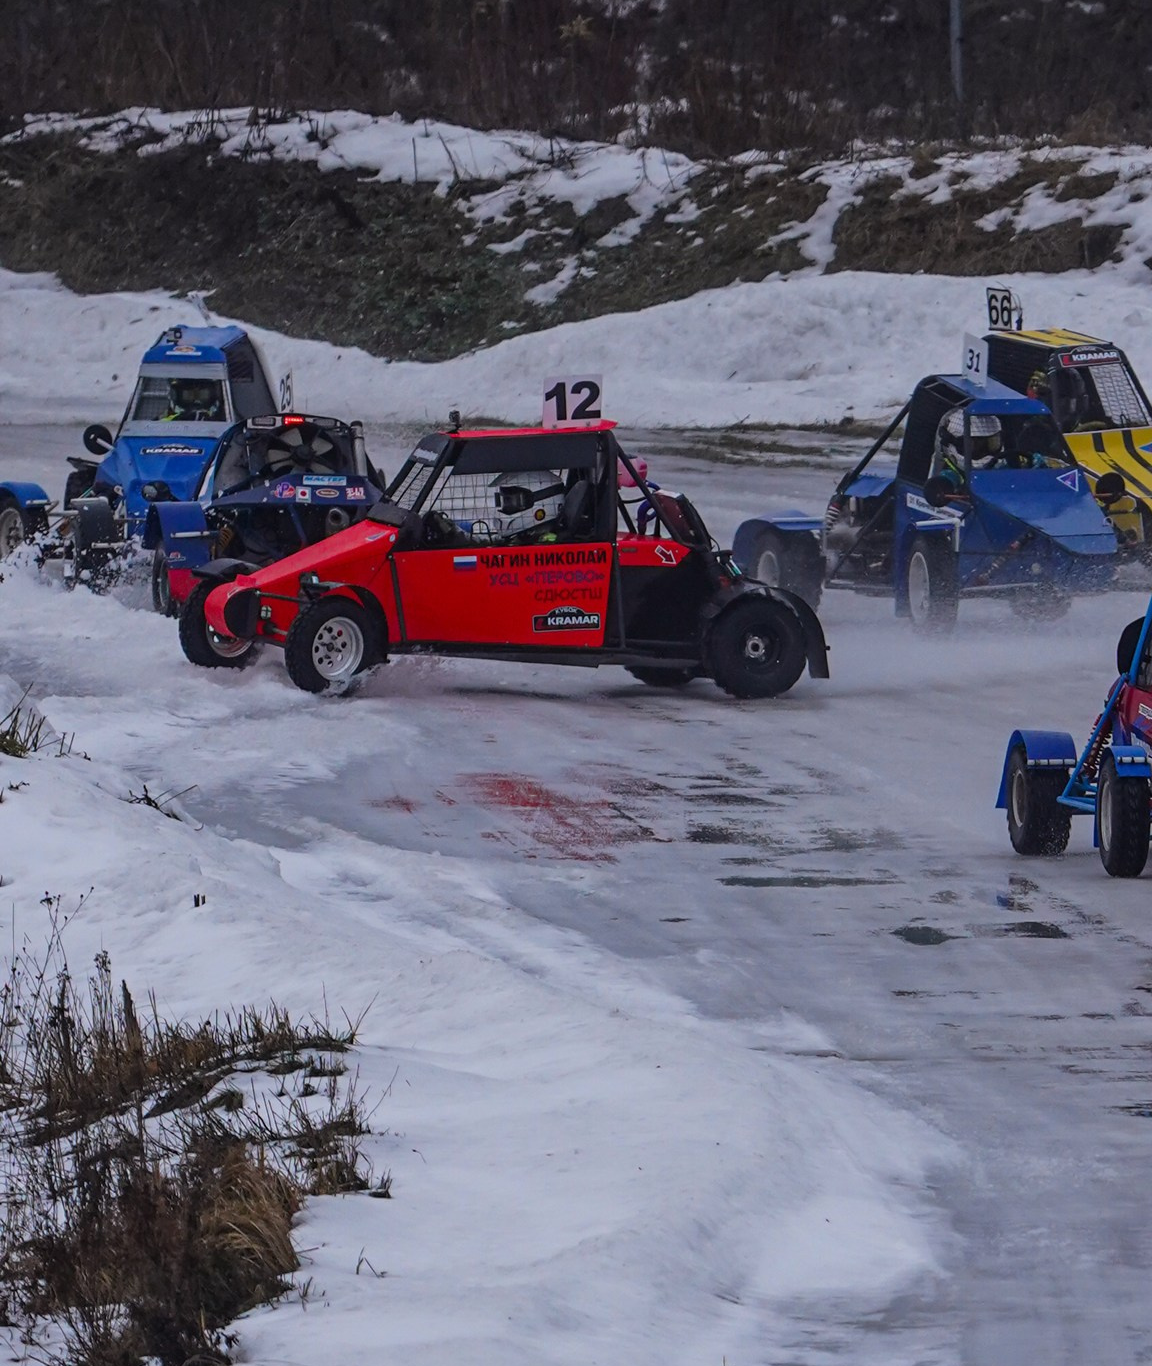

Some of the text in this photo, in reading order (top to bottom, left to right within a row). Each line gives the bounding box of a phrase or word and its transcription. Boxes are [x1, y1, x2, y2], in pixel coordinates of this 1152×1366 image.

[988, 293, 1011, 327] 66
[966, 348, 981, 373] 31
[1072, 351, 1118, 362] KRAMAR
[279, 373, 292, 412] 25
[545, 380, 601, 421] 12
[480, 547, 607, 569] ЧАГИН НИКОЛАЙ
[490, 573, 519, 586] УСЦ
[534, 587, 603, 602] СДЮСТШ
[547, 615, 598, 626] KRAMAR
